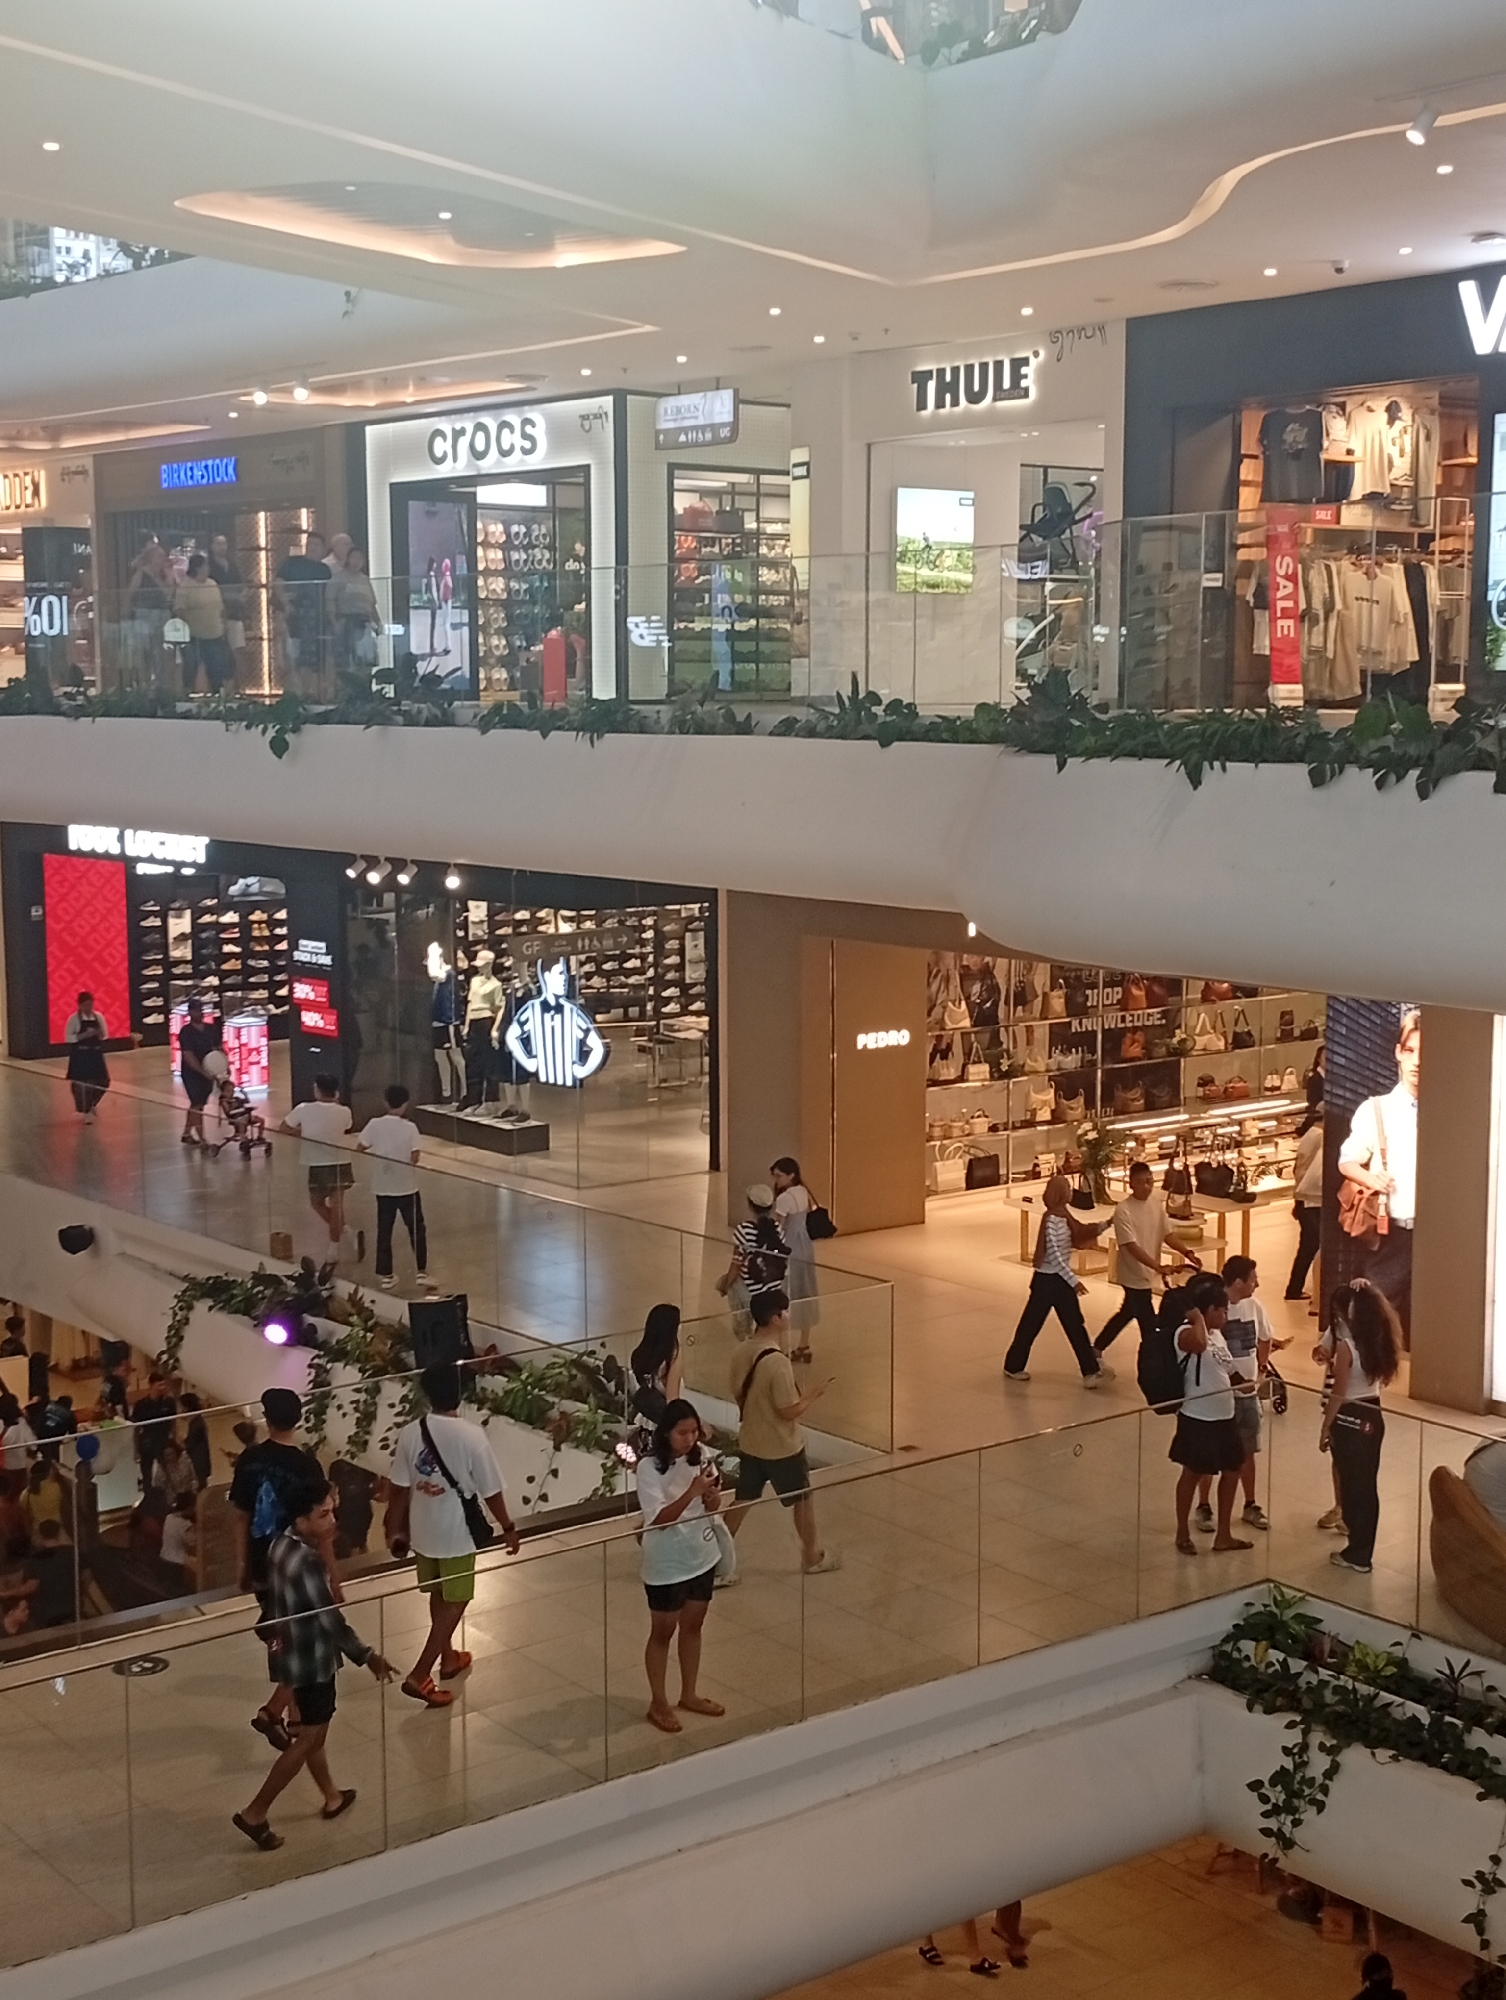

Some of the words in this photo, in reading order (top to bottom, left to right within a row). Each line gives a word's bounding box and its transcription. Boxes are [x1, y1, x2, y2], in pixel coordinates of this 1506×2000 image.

[1458, 274, 1506, 354] V
[911, 356, 1029, 412] THULE
[663, 403, 700, 417] REBORN
[428, 416, 540, 466] crocs
[720, 426, 731, 438] UG
[0, 470, 47, 513] DDEN
[161, 456, 237, 489] BIRKENSTOCK
[1276, 555, 1295, 638] SALE
[522, 941, 541, 955] GF
[856, 1028, 910, 1050] PEDRO
